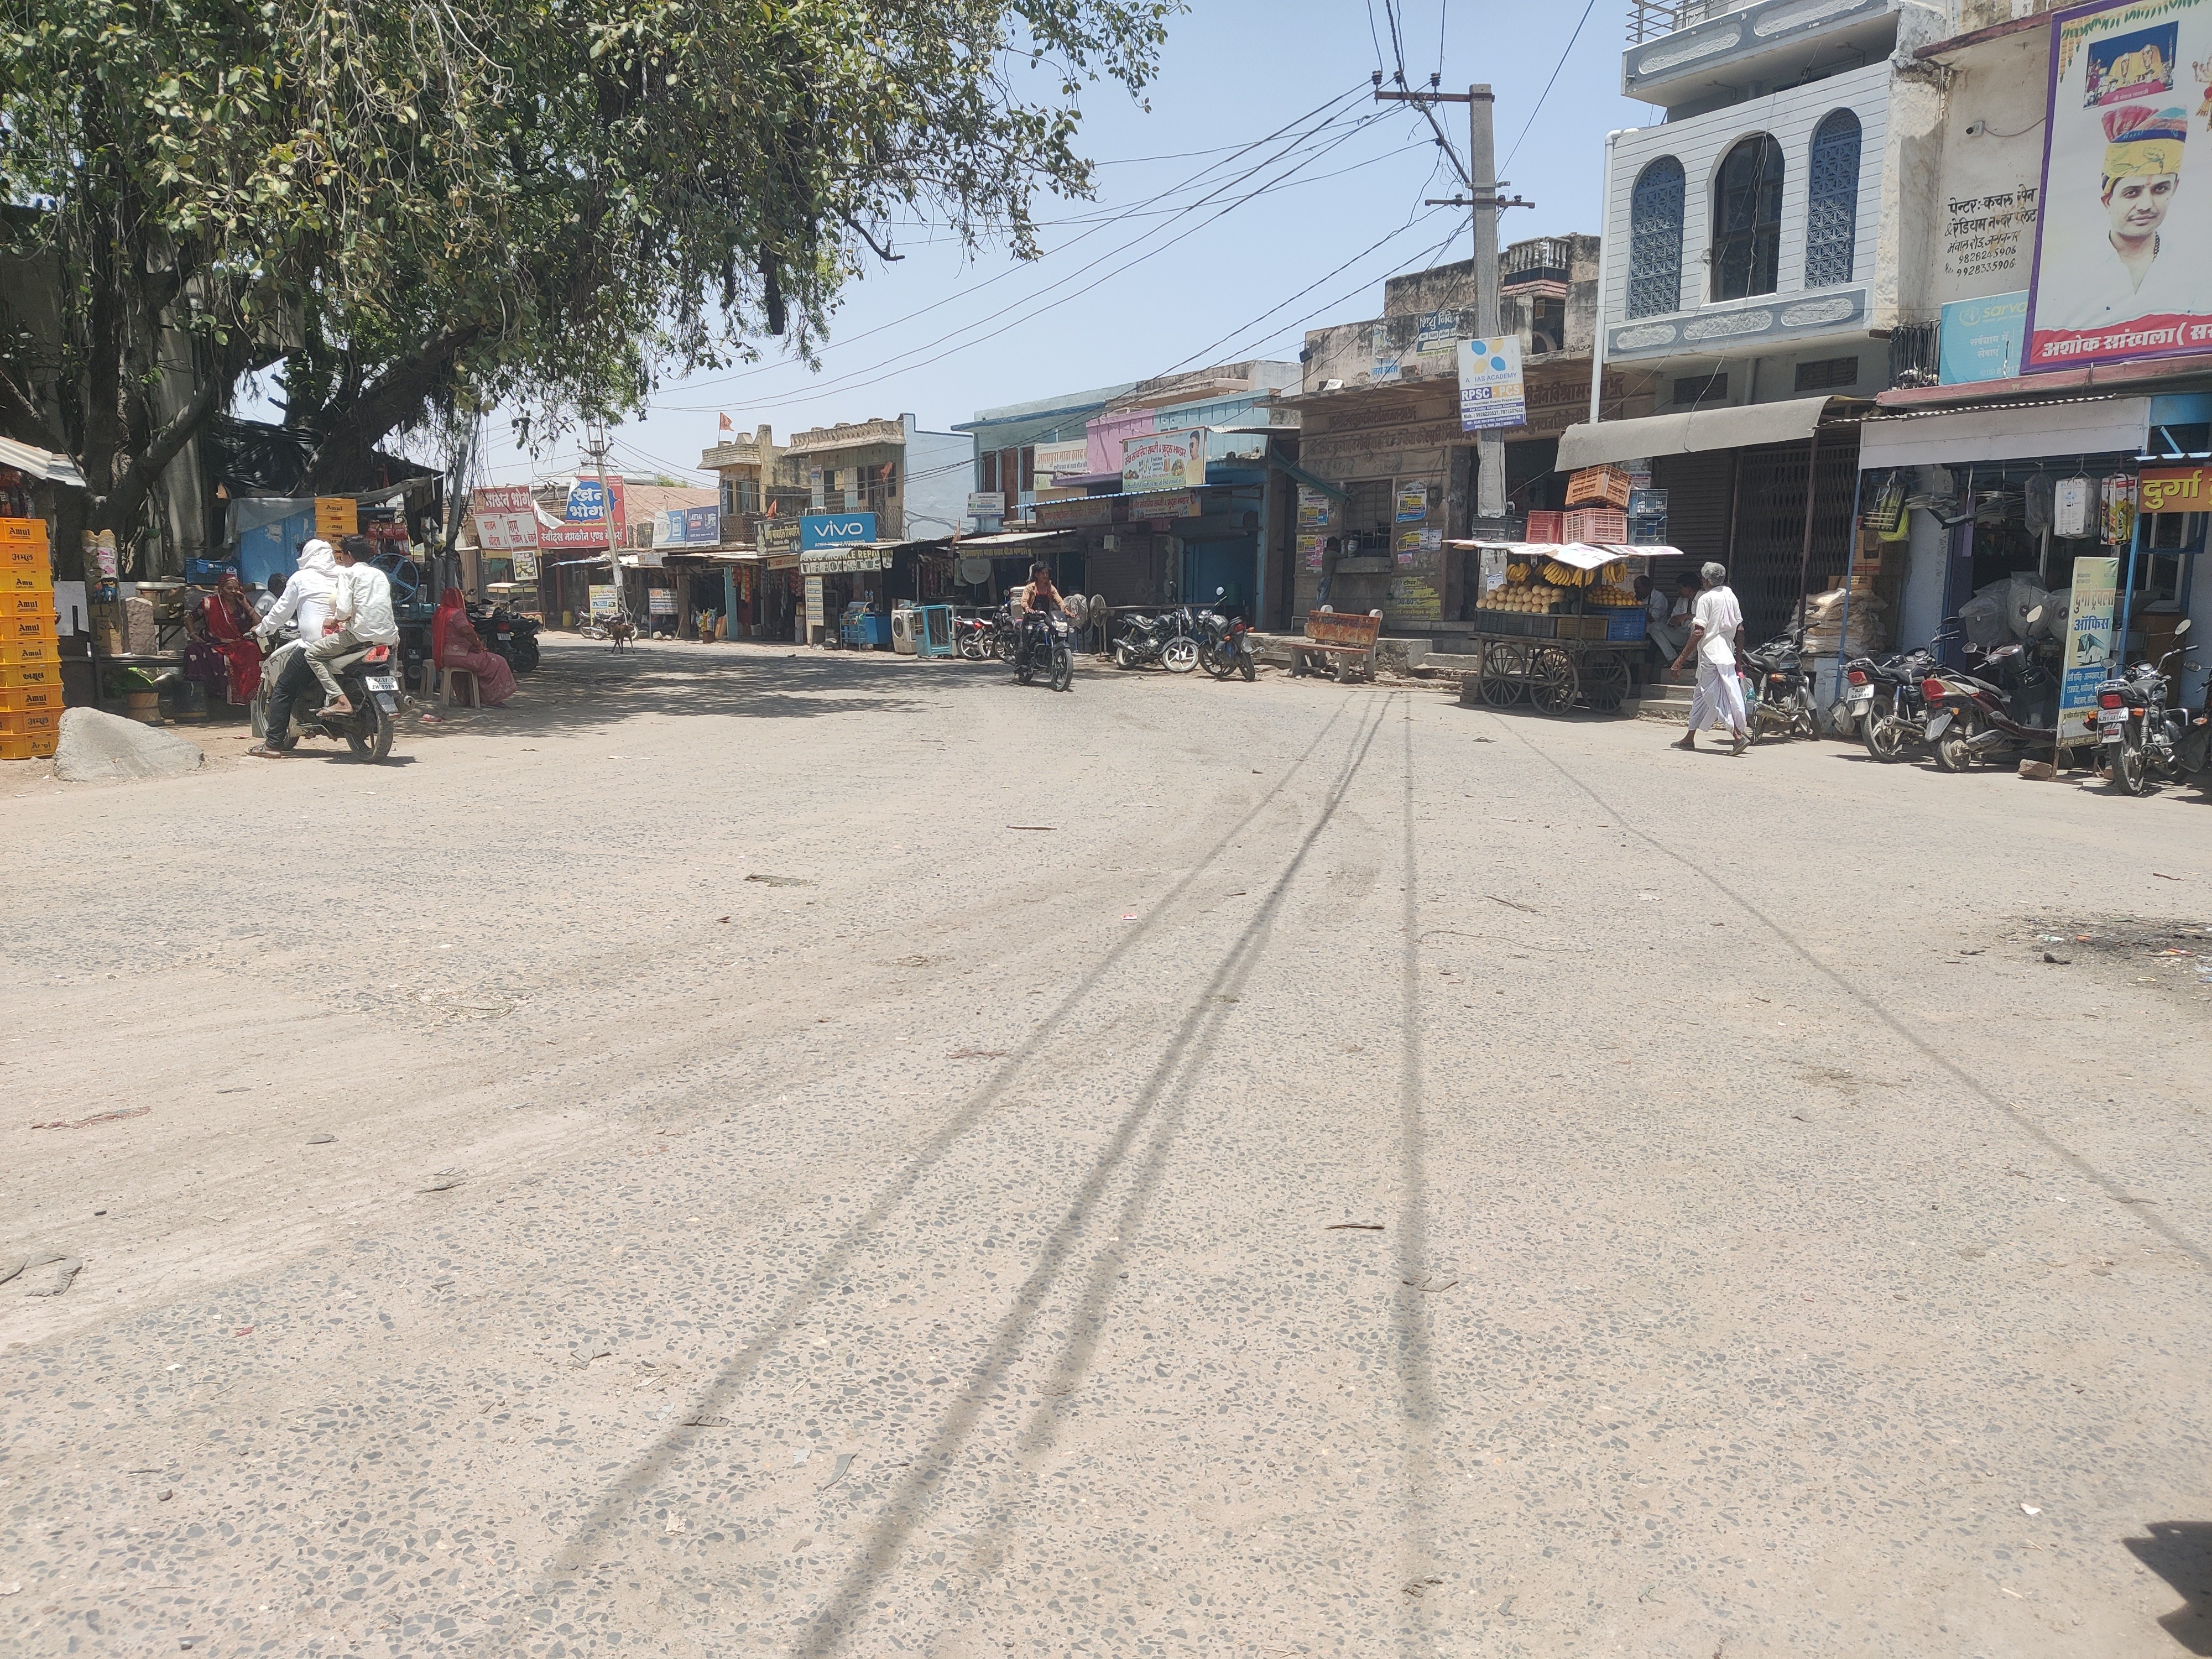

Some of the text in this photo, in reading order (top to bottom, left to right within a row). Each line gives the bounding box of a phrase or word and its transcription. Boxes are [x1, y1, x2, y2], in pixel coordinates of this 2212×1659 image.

[2042, 334, 2102, 357] अशोक
[2104, 327, 2177, 350] सांखला
[1486, 372, 1517, 382] ACADEMY
[1461, 384, 1520, 401] RPSC PCS
[2142, 469, 2203, 509] दुर्गा
[511, 488, 531, 508] भोग
[569, 502, 604, 518] भोग
[9, 526, 30, 536] Amul
[541, 529, 563, 545] स्वीट्स
[565, 529, 589, 542] नमकीन
[590, 530, 604, 542] एण्ड
[814, 520, 863, 538] vivo
[17, 600, 38, 608] Amul
[18, 623, 40, 632] Amul
[2074, 615, 2110, 631] ऑफिस
[22, 649, 42, 657] Amul
[25, 694, 47, 703] Amul
